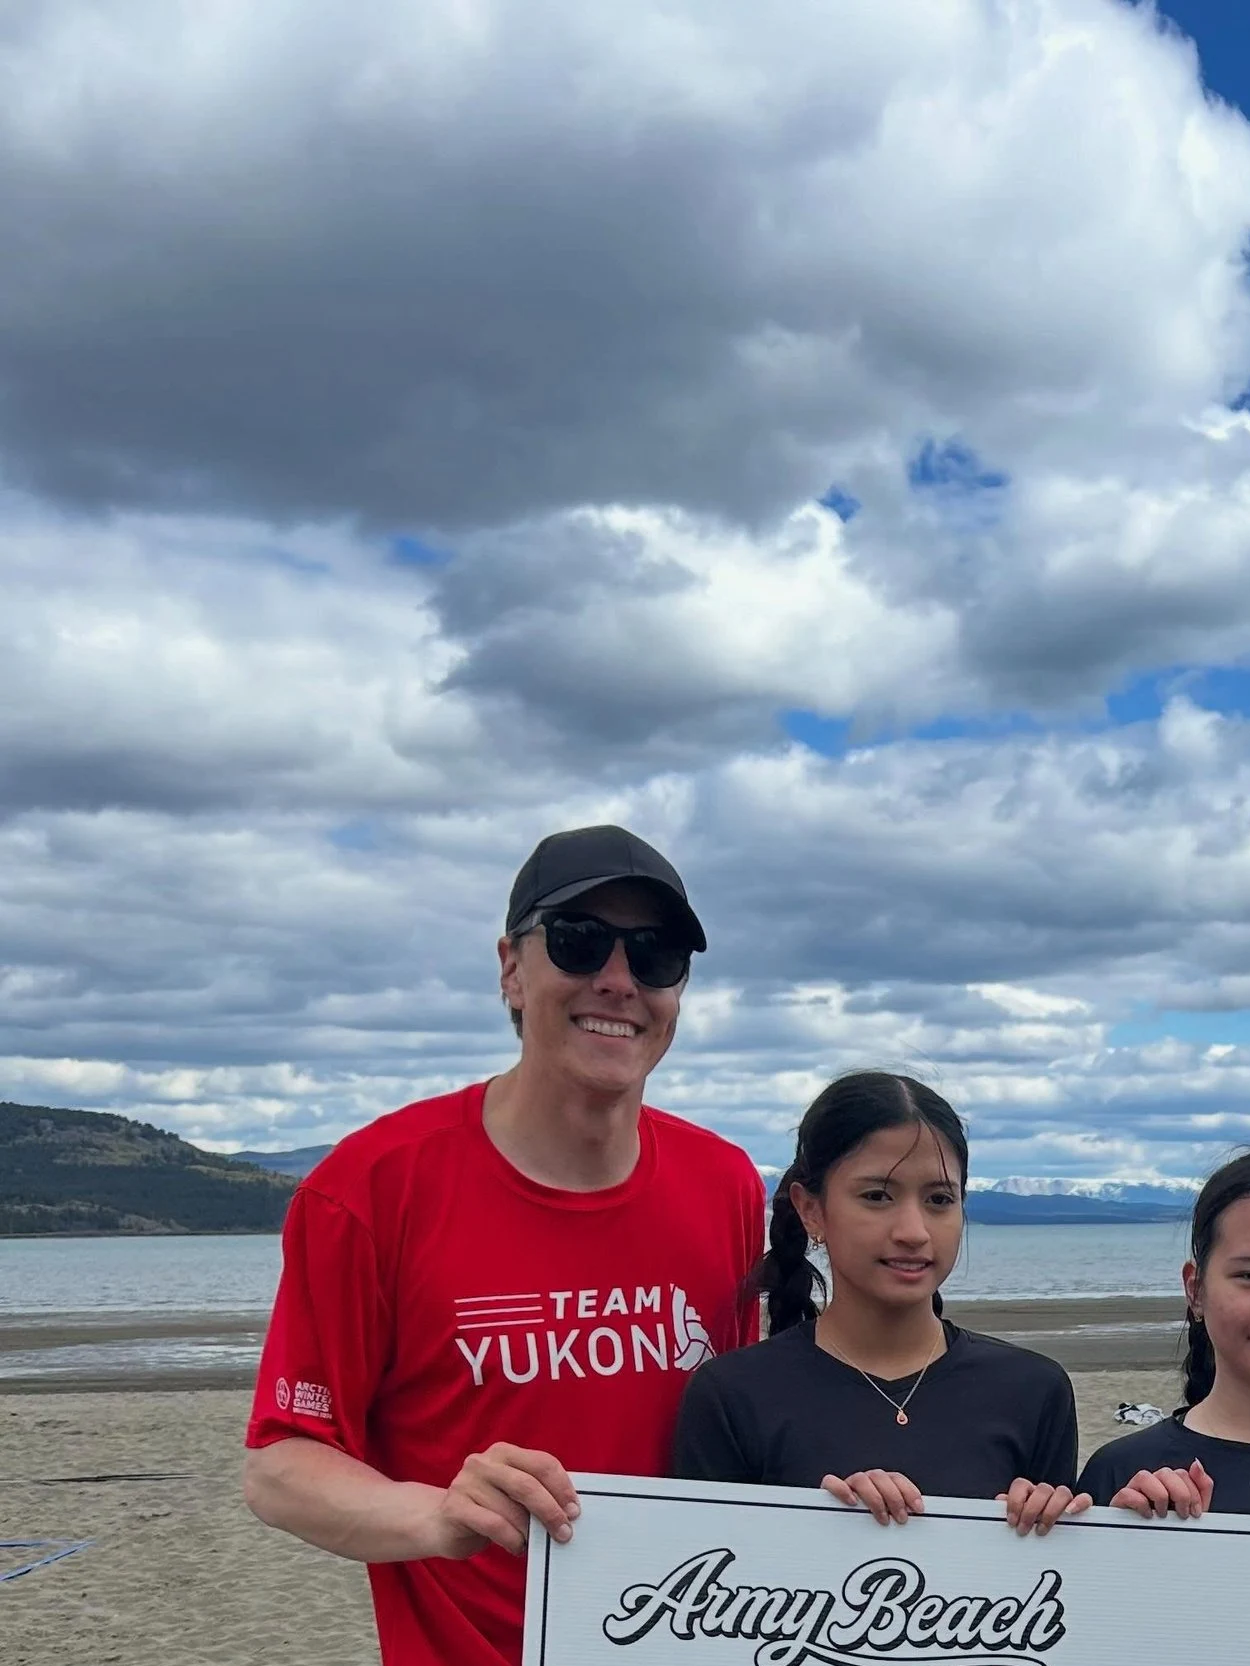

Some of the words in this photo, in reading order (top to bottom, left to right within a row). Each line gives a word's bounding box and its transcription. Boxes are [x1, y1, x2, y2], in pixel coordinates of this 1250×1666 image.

[549, 1286, 661, 1319] TEAM
[455, 1323, 668, 1386] YUKON
[293, 1399, 330, 1413] GAMES
[827, 1556, 1067, 1652] Beach
